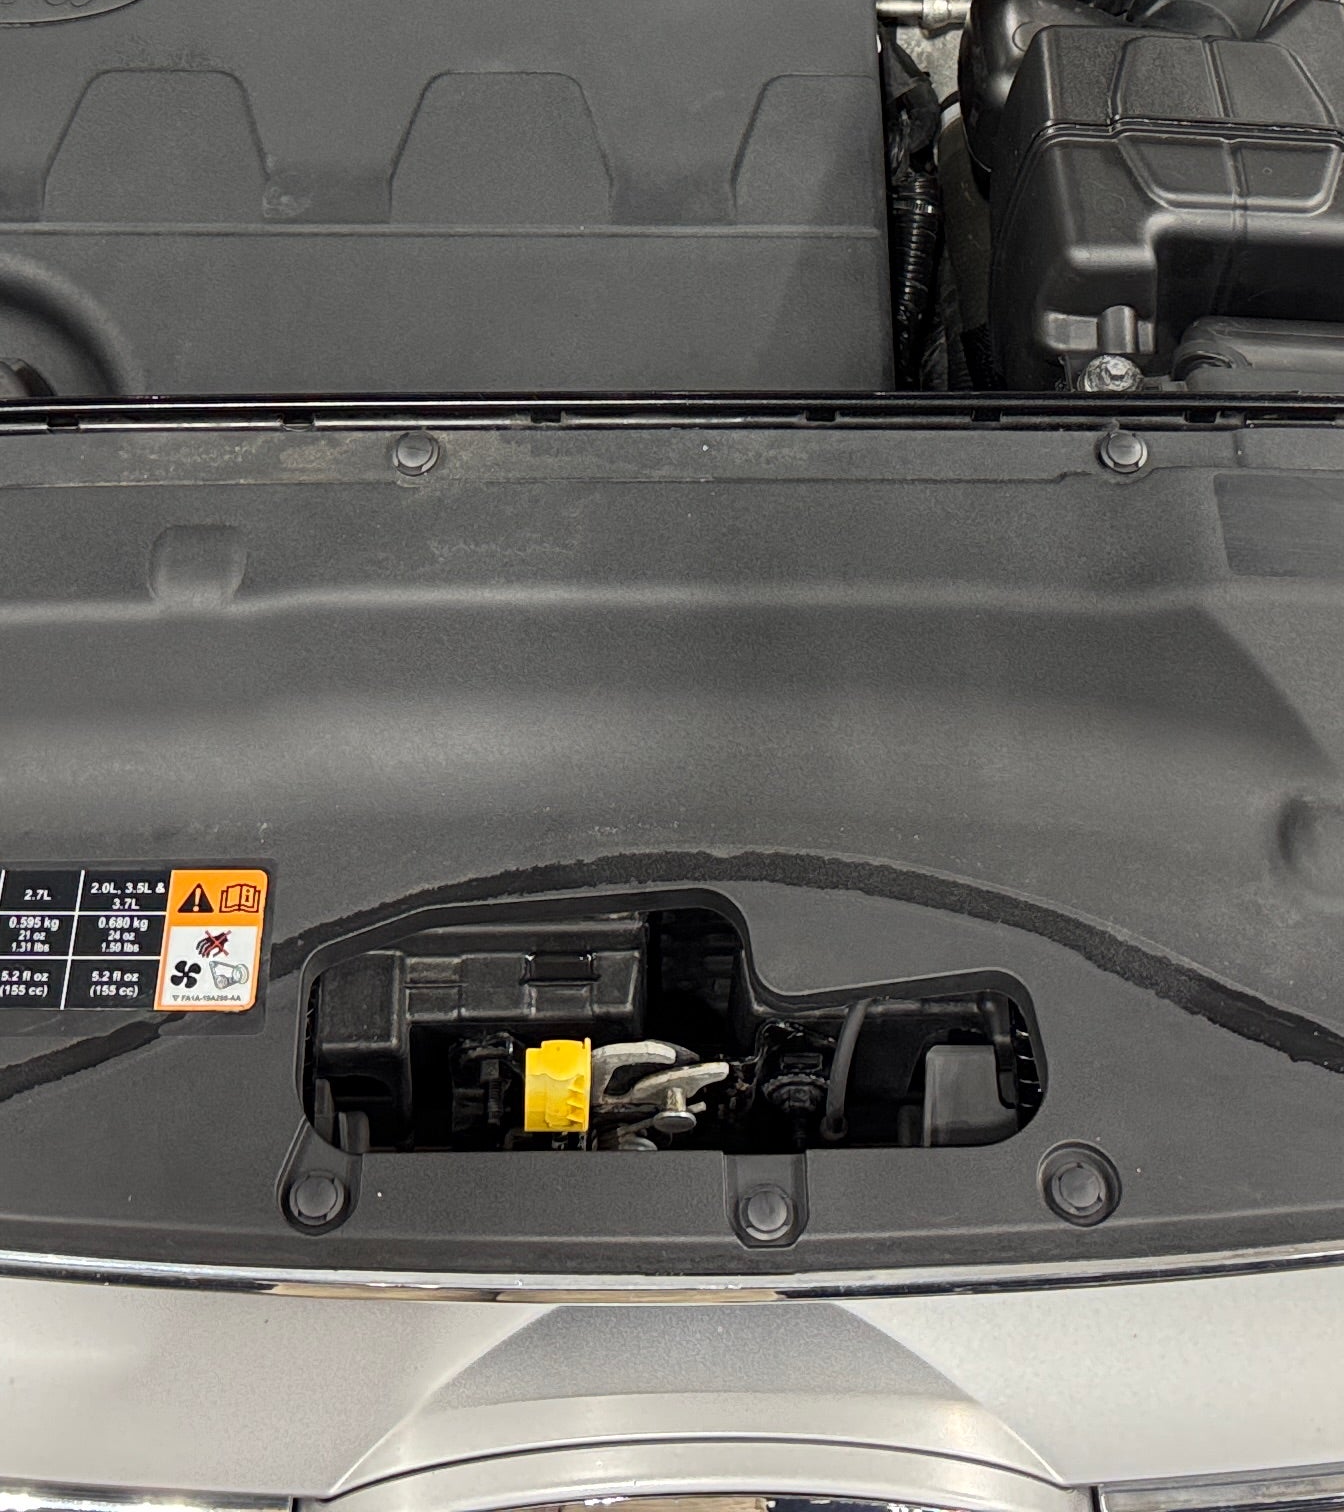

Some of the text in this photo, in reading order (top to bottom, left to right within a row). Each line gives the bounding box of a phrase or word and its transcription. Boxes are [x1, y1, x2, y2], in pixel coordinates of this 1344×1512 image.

[90, 882, 166, 894] 2.0L, 3.5L &
[23, 889, 52, 901] 2.7L
[111, 898, 140, 910] 3.7L
[8, 916, 60, 932] 0.595 kg
[97, 916, 149, 932] 0.680 kg
[17, 930, 46, 941] 21 oz
[107, 930, 136, 941] 24 oz
[11, 941, 50, 953] 1.31 lbs
[101, 941, 140, 953] 1.50 lbs
[1, 970, 49, 983] 5.2 fl oz
[91, 970, 139, 983] 5.2 fl oz
[27, 984, 48, 998] cc)
[89, 984, 139, 998] (155 cc)
